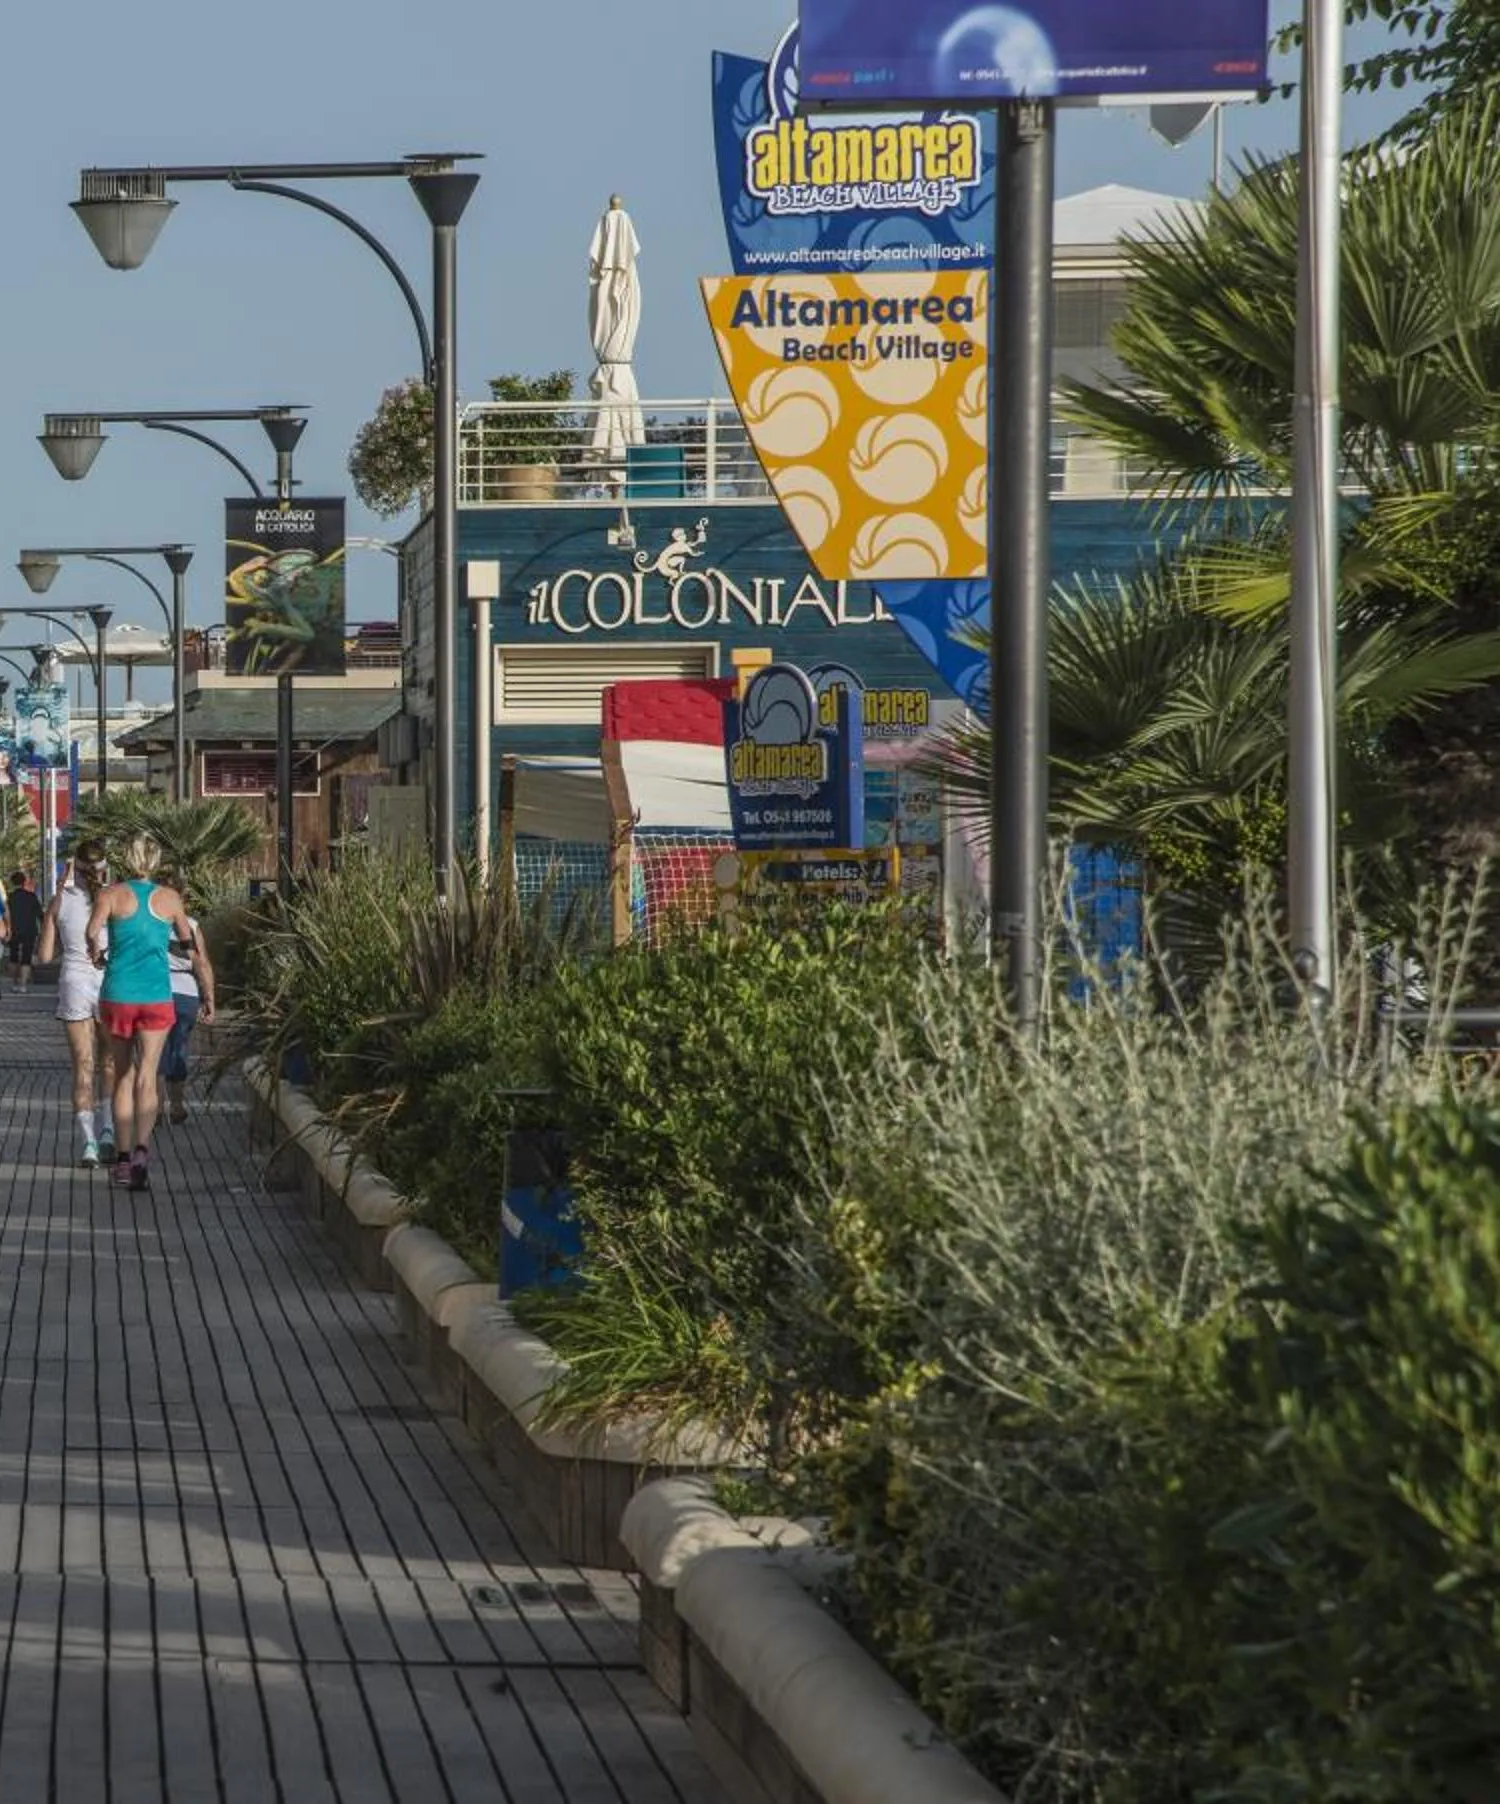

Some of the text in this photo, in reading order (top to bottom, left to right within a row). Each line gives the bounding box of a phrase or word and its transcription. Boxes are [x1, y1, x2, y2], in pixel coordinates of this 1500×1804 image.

[754, 117, 974, 190] altamarea
[773, 176, 957, 209] BEACH VILLAGE
[744, 242, 986, 265] www.altamareabeachvillage.it
[730, 288, 974, 328] Altamarea
[782, 335, 974, 363] Beach Village
[819, 683, 929, 726] almarea
[732, 739, 823, 782] altamarea
